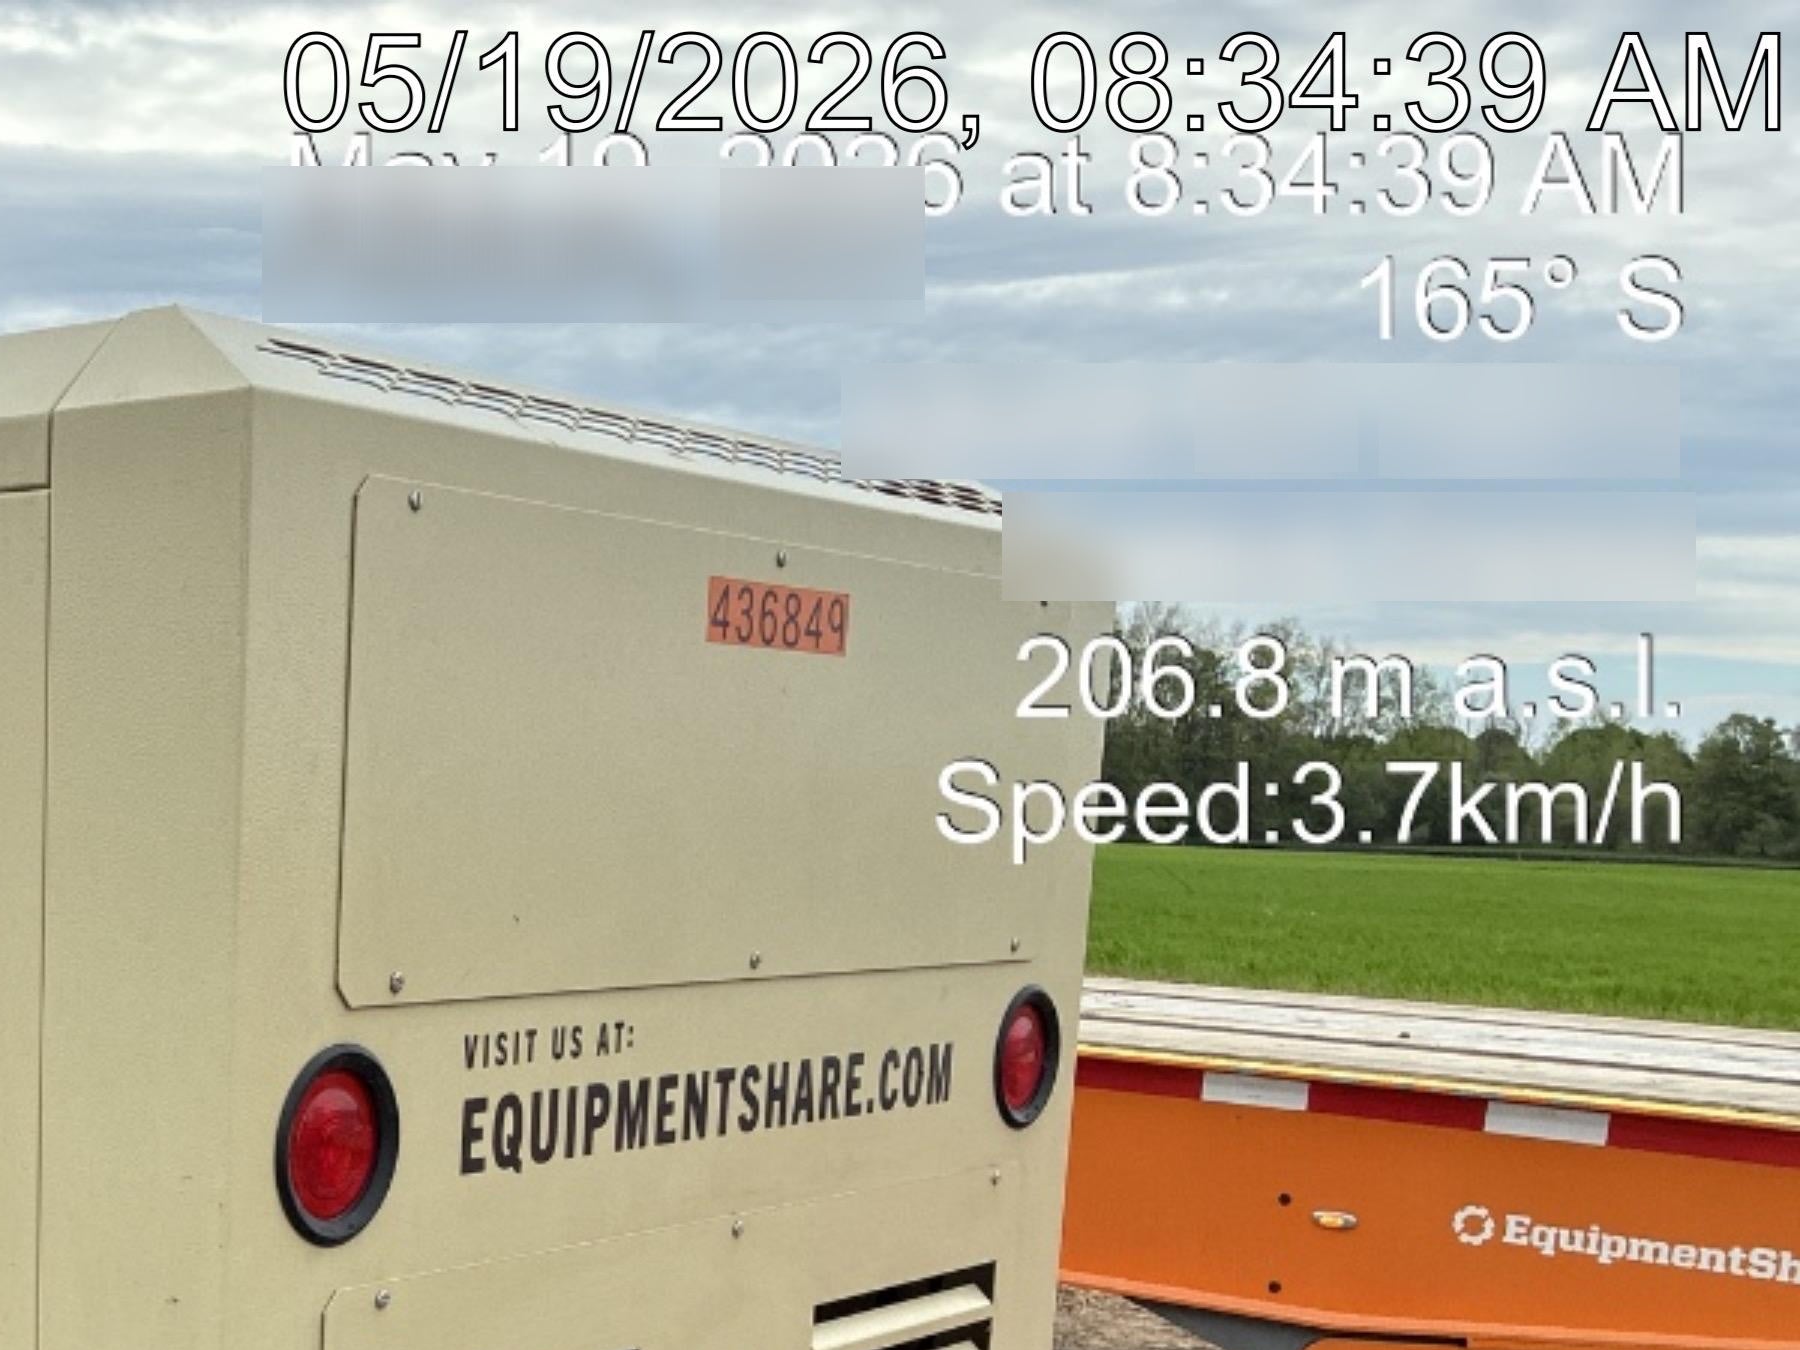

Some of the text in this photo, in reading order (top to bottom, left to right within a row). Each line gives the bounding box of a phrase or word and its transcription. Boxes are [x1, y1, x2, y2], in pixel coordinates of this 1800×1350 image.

[709, 582, 845, 651] 436849
[463, 1020, 635, 1069] VISIT US AT:
[458, 1041, 955, 1176] EQUIPMENTSHARE.COM
